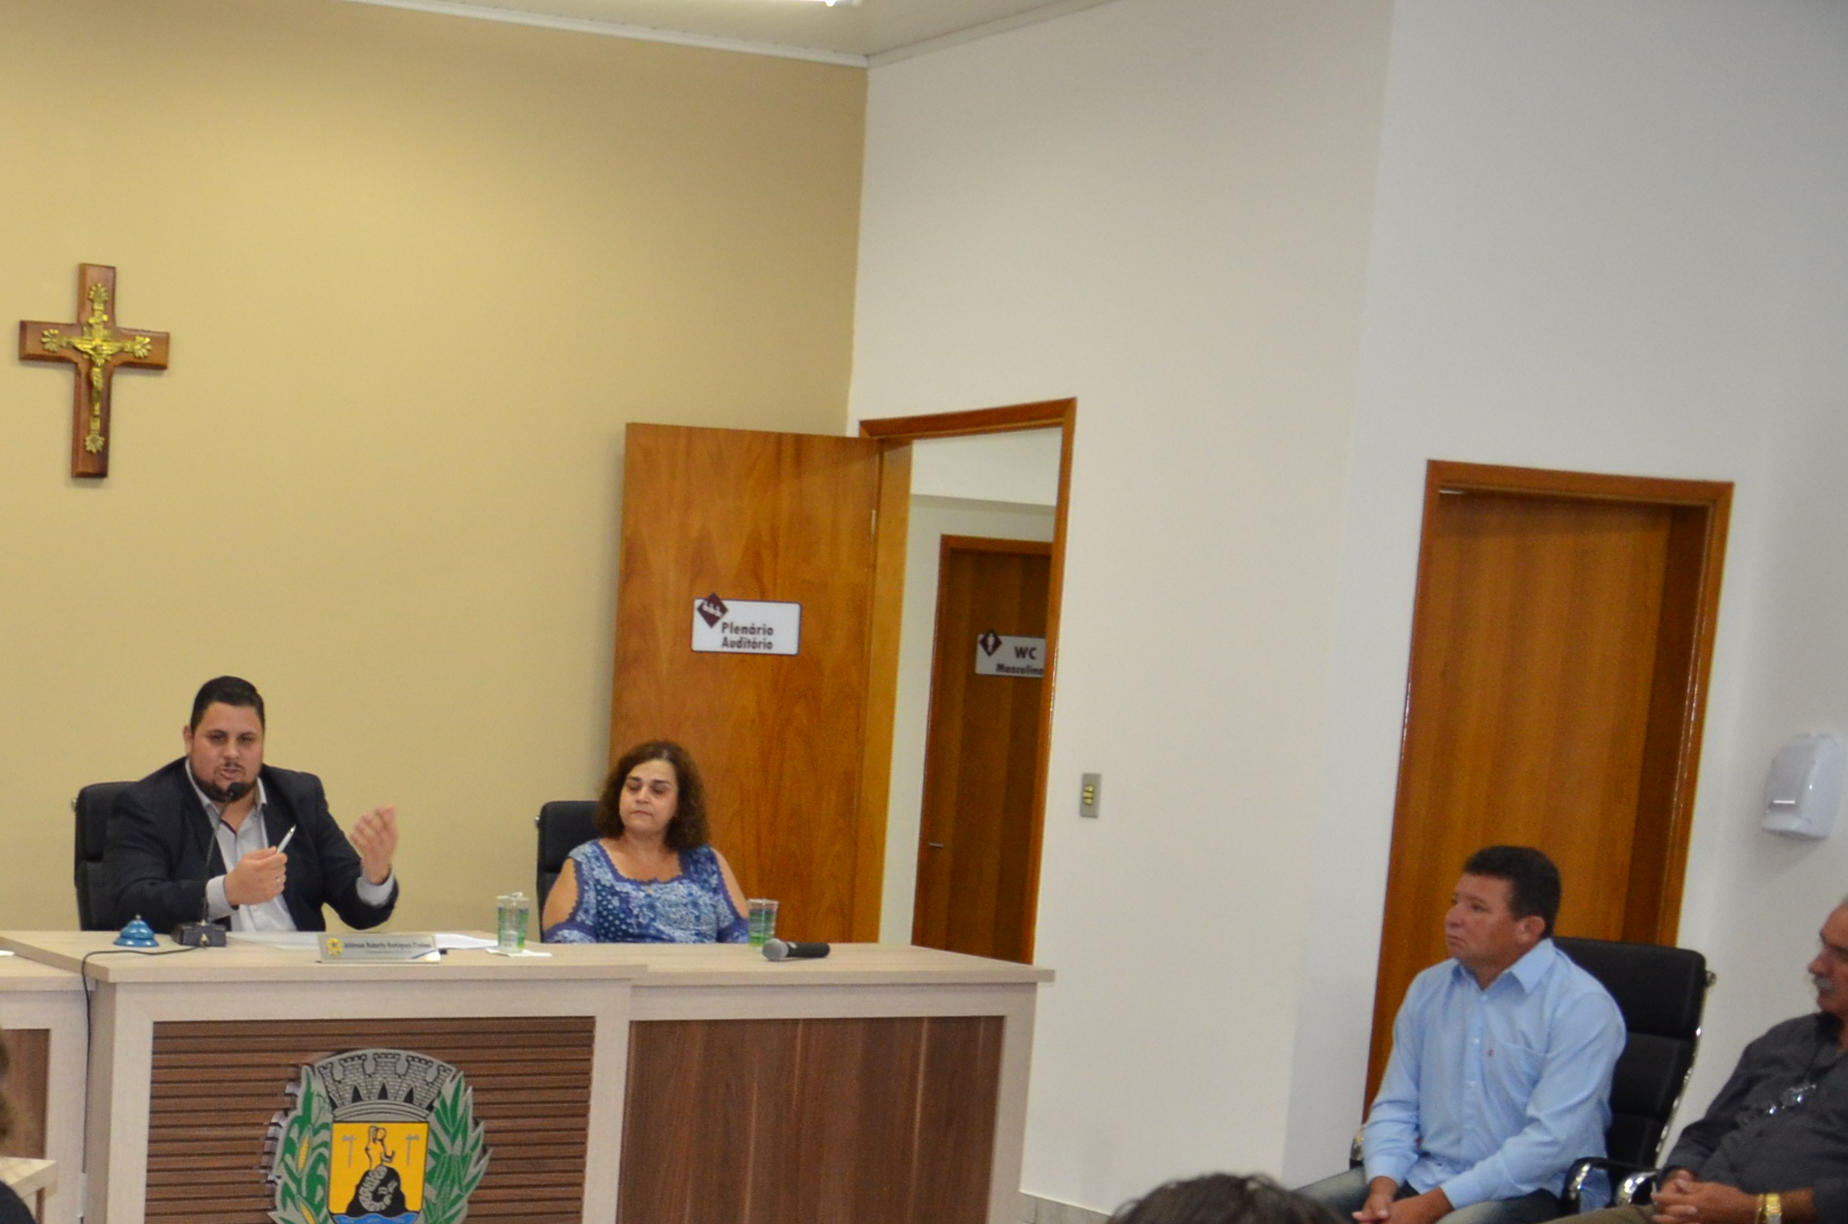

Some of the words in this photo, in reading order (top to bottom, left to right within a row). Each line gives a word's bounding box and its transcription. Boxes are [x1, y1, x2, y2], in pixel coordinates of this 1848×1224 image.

[721, 621, 774, 636] Plenário
[721, 636, 774, 650] Auditório
[1014, 645, 1037, 660] WC
